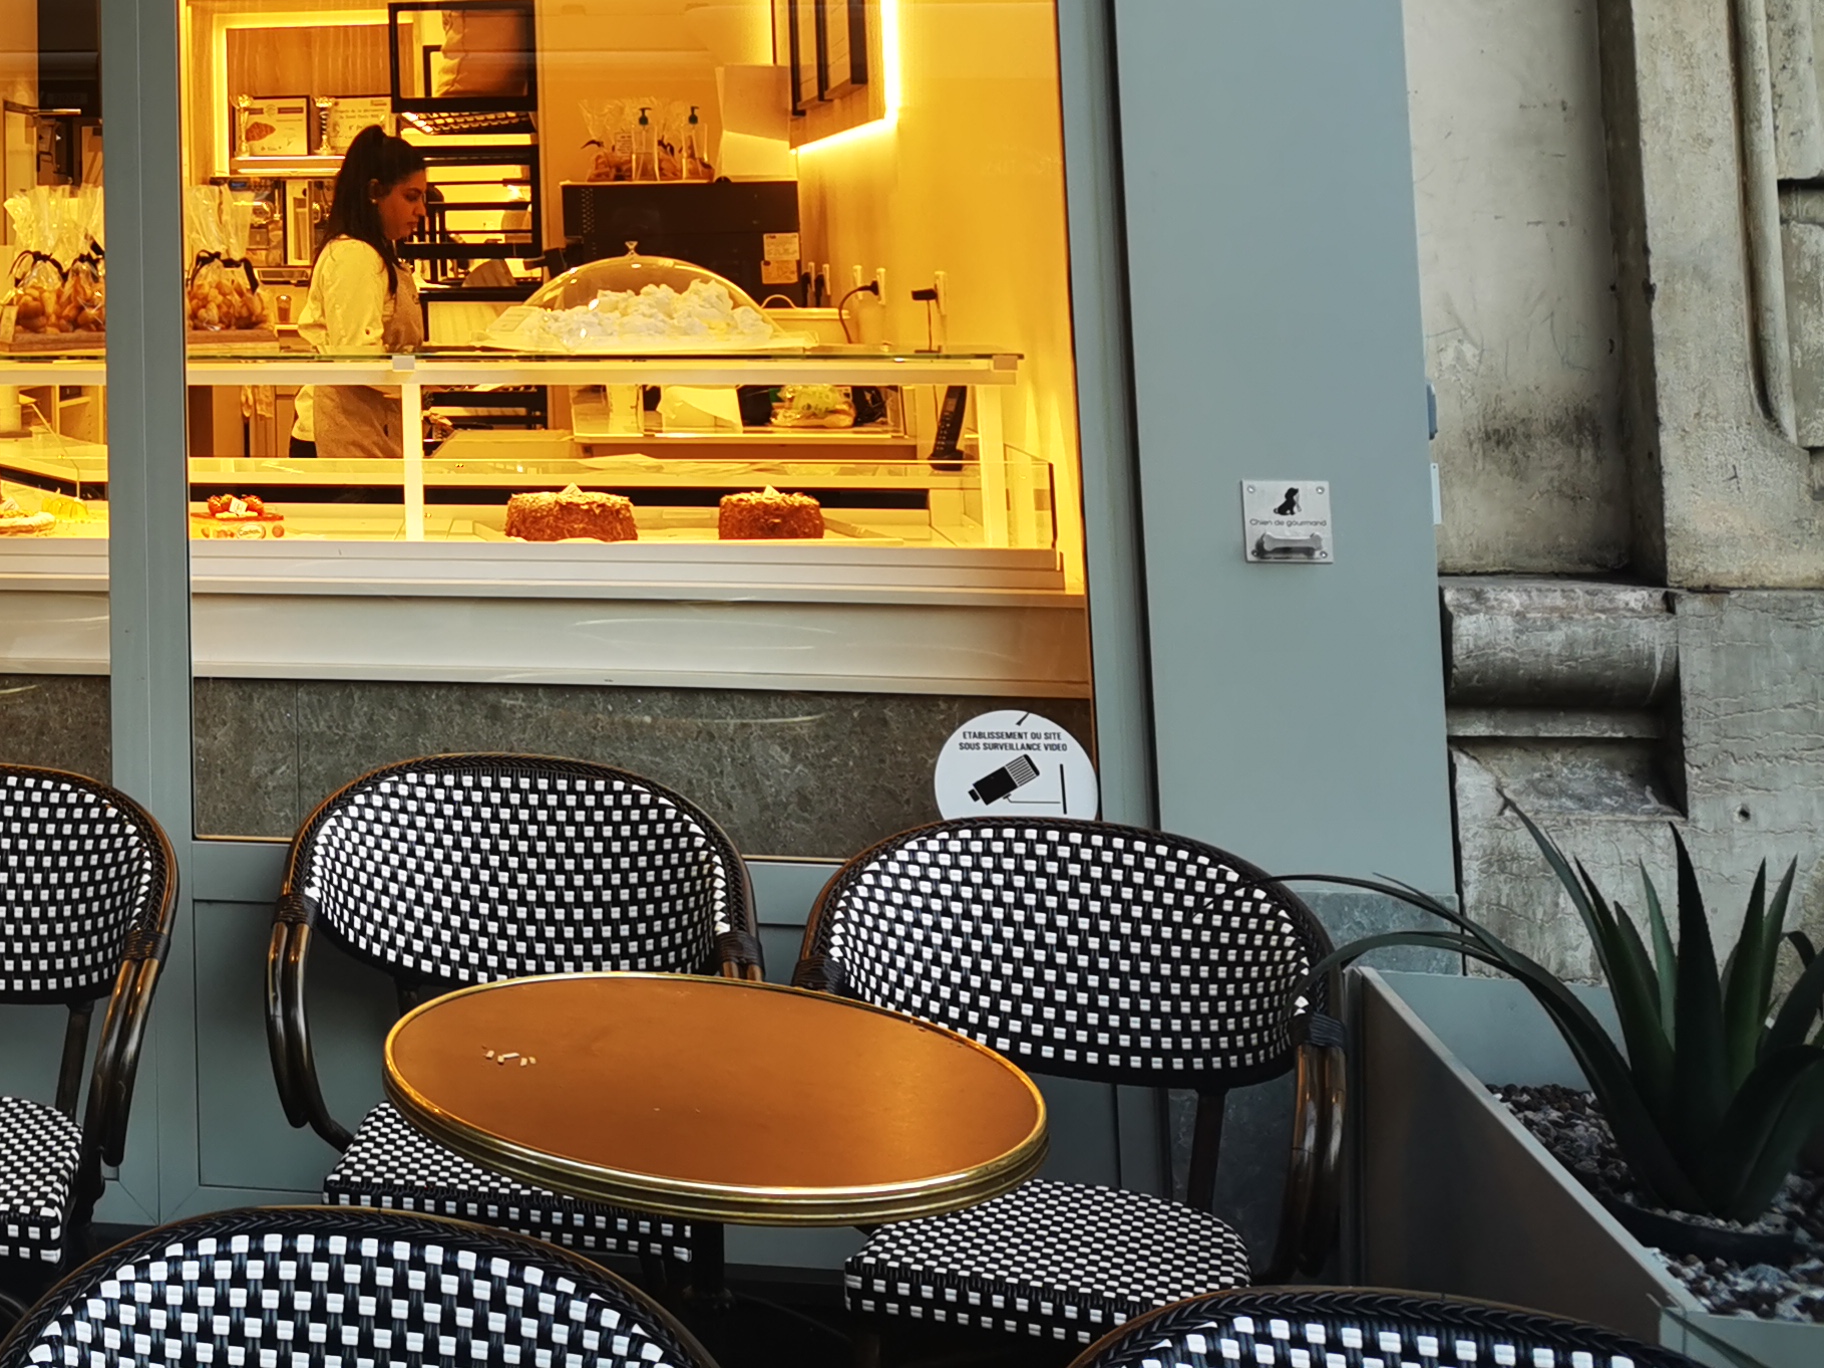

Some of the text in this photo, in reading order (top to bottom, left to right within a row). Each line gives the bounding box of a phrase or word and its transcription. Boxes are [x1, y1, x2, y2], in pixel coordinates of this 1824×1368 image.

[962, 731, 1062, 740] ETABLISSEMENT OU SITE
[958, 742, 1068, 752] SOUS SURVEILLANCE VIDEO
